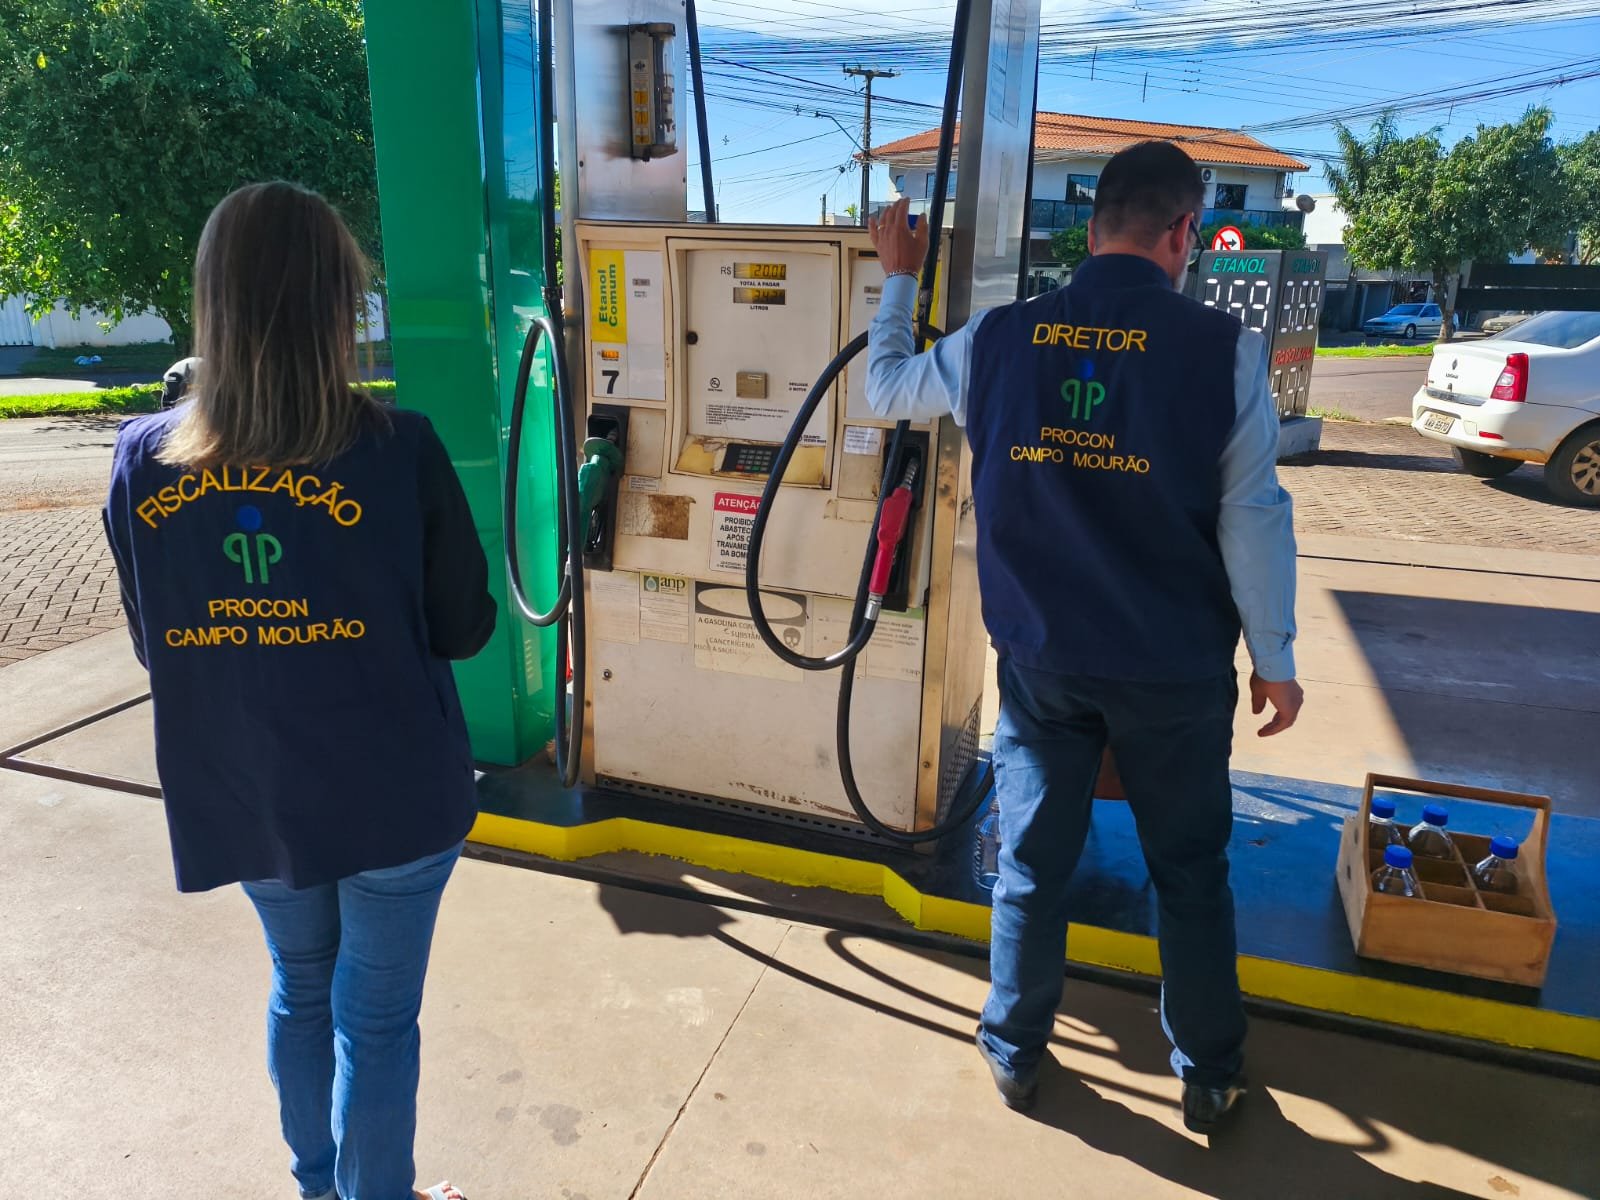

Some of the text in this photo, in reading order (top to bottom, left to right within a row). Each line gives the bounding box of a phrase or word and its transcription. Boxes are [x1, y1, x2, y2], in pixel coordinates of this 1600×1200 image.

[1212, 257, 1266, 273] ETANOL
[597, 269, 608, 323] Etanol
[608, 263, 618, 327] Comum
[1032, 323, 1148, 352] DIRETOR
[602, 369, 620, 395] 7
[1040, 427, 1115, 449] PROCON
[1010, 446, 1150, 473] CAMPO MOURÃO
[136, 465, 363, 529] FISCALIZAÇÃO
[720, 524, 751, 534] ABASTEC
[660, 577, 686, 592] anp
[208, 599, 308, 618] PROCON
[165, 618, 365, 647] CAMPO MOURÃO
